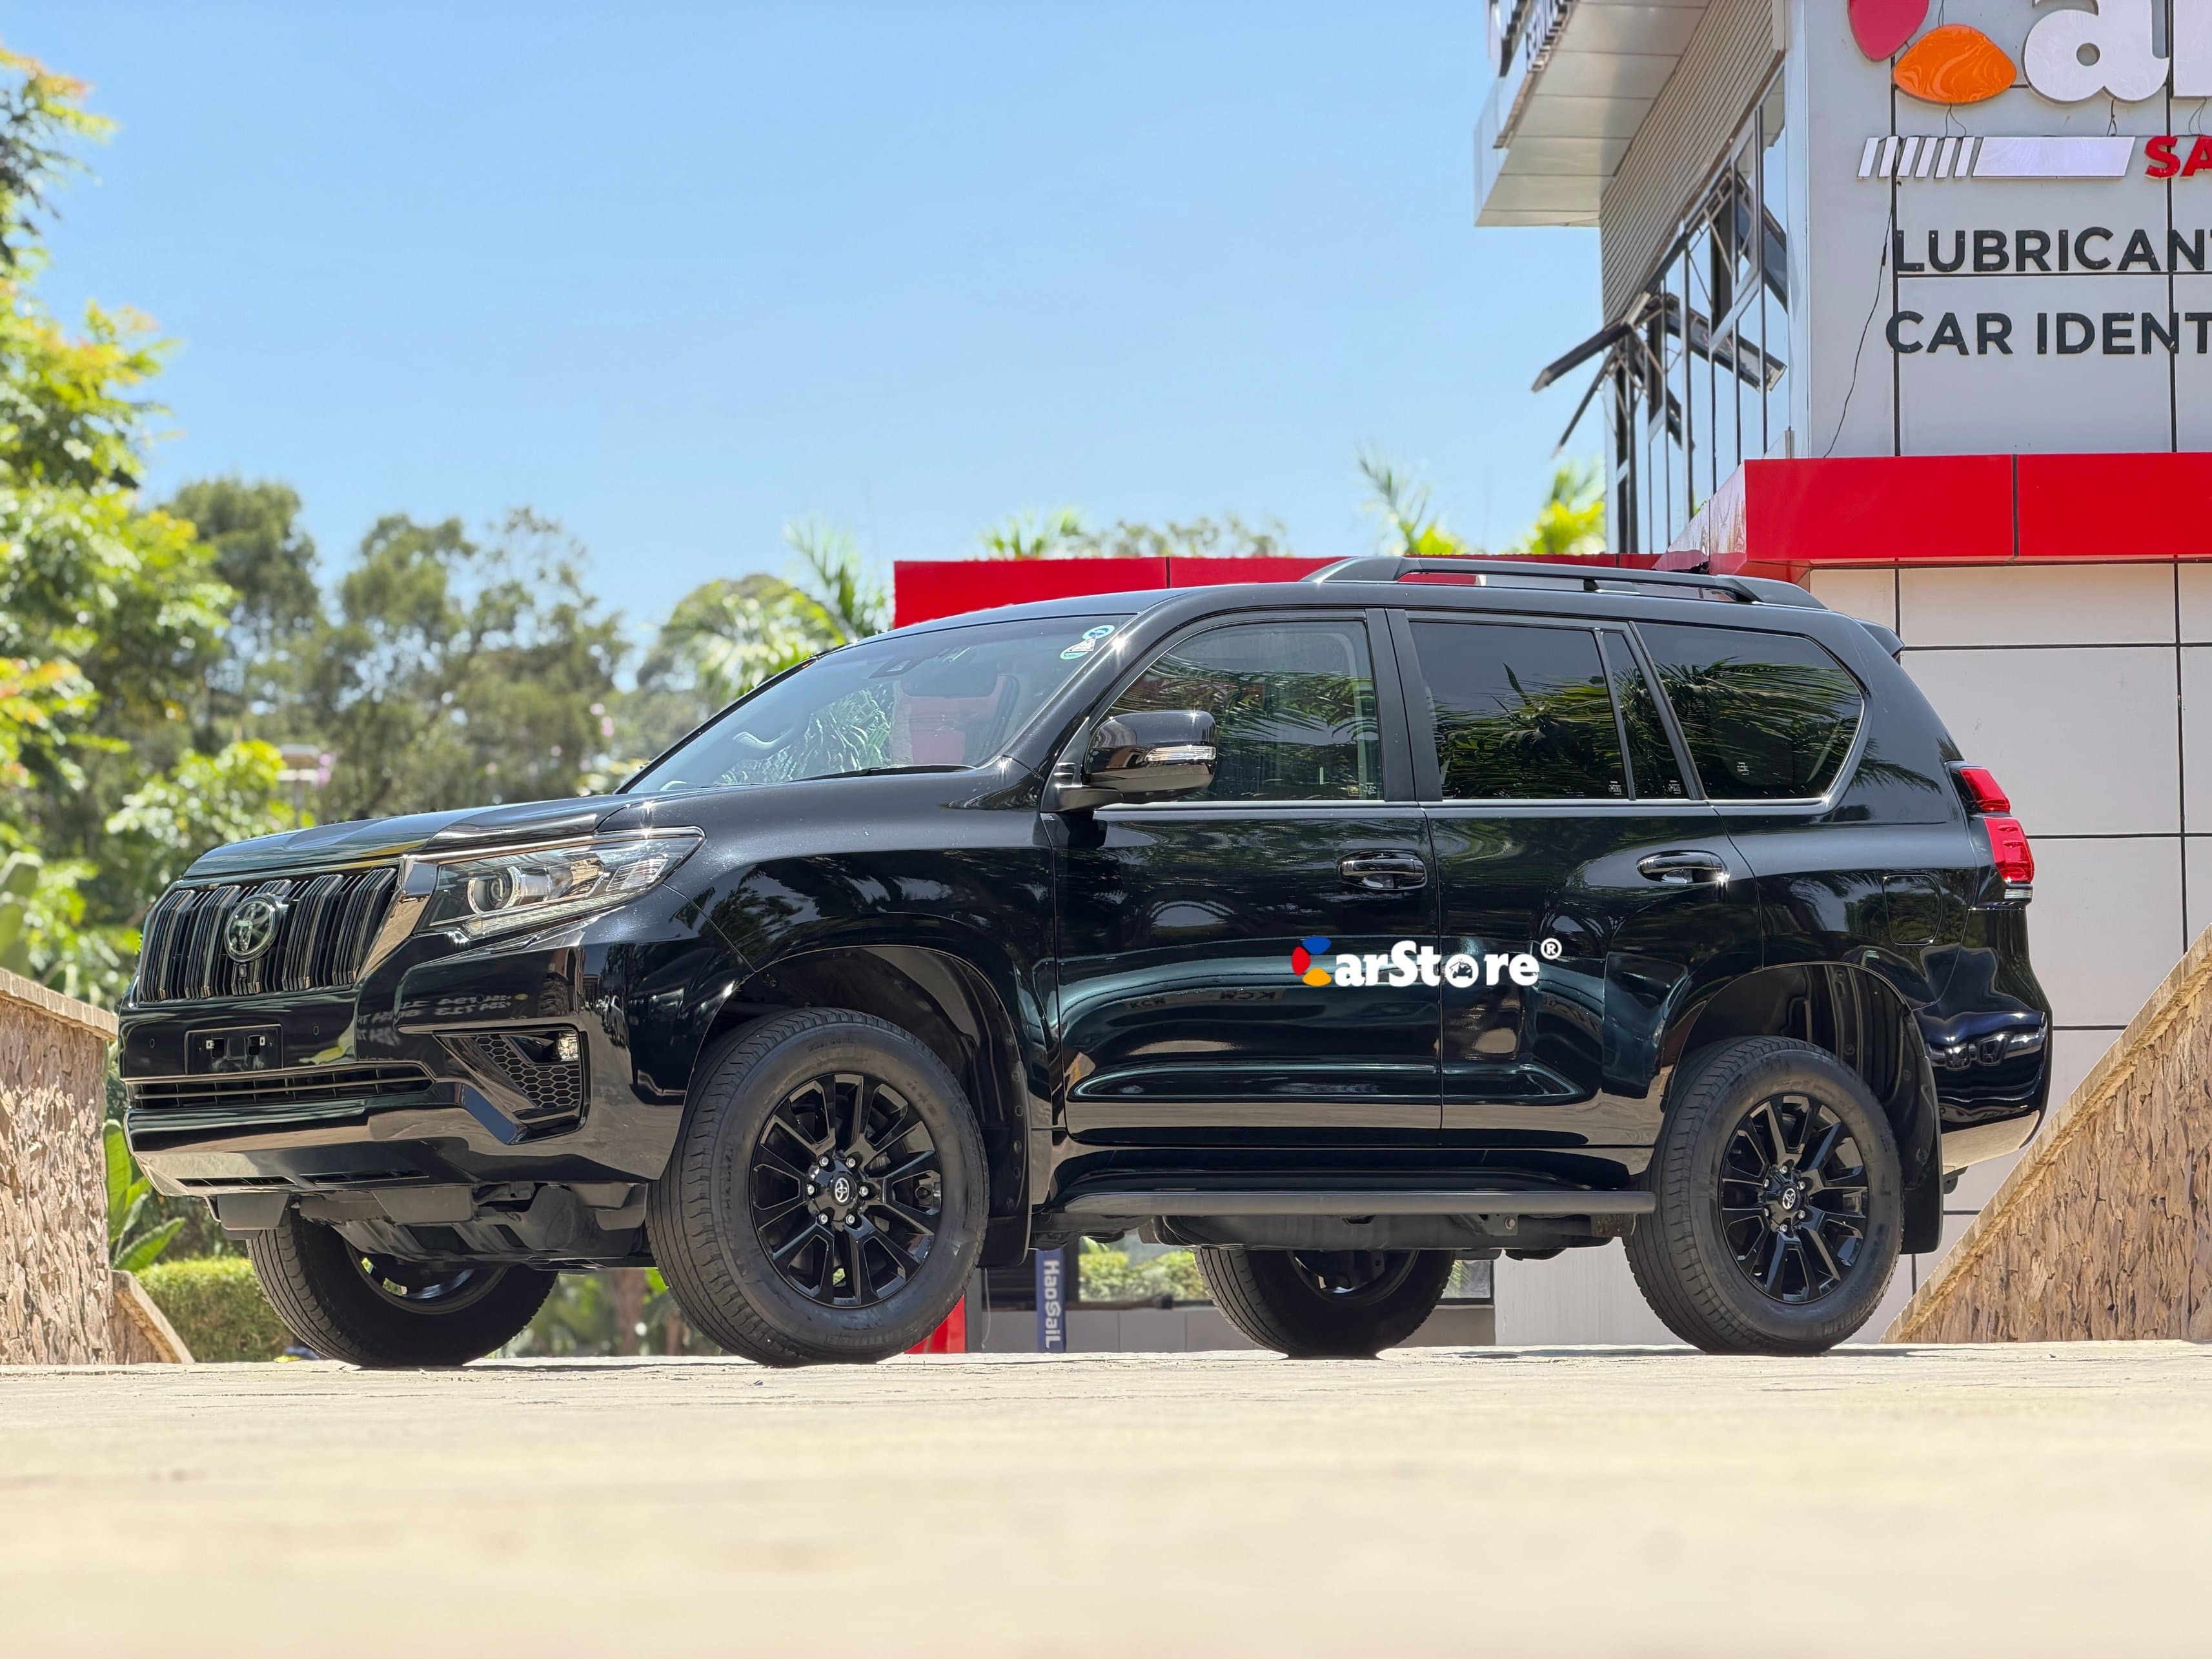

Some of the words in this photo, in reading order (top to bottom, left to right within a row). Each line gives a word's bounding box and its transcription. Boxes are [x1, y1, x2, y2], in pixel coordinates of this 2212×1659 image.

[1896, 227, 2212, 272] LUBRICAN
[1885, 310, 2013, 355] CAR
[2037, 312, 2212, 354] IDENT
